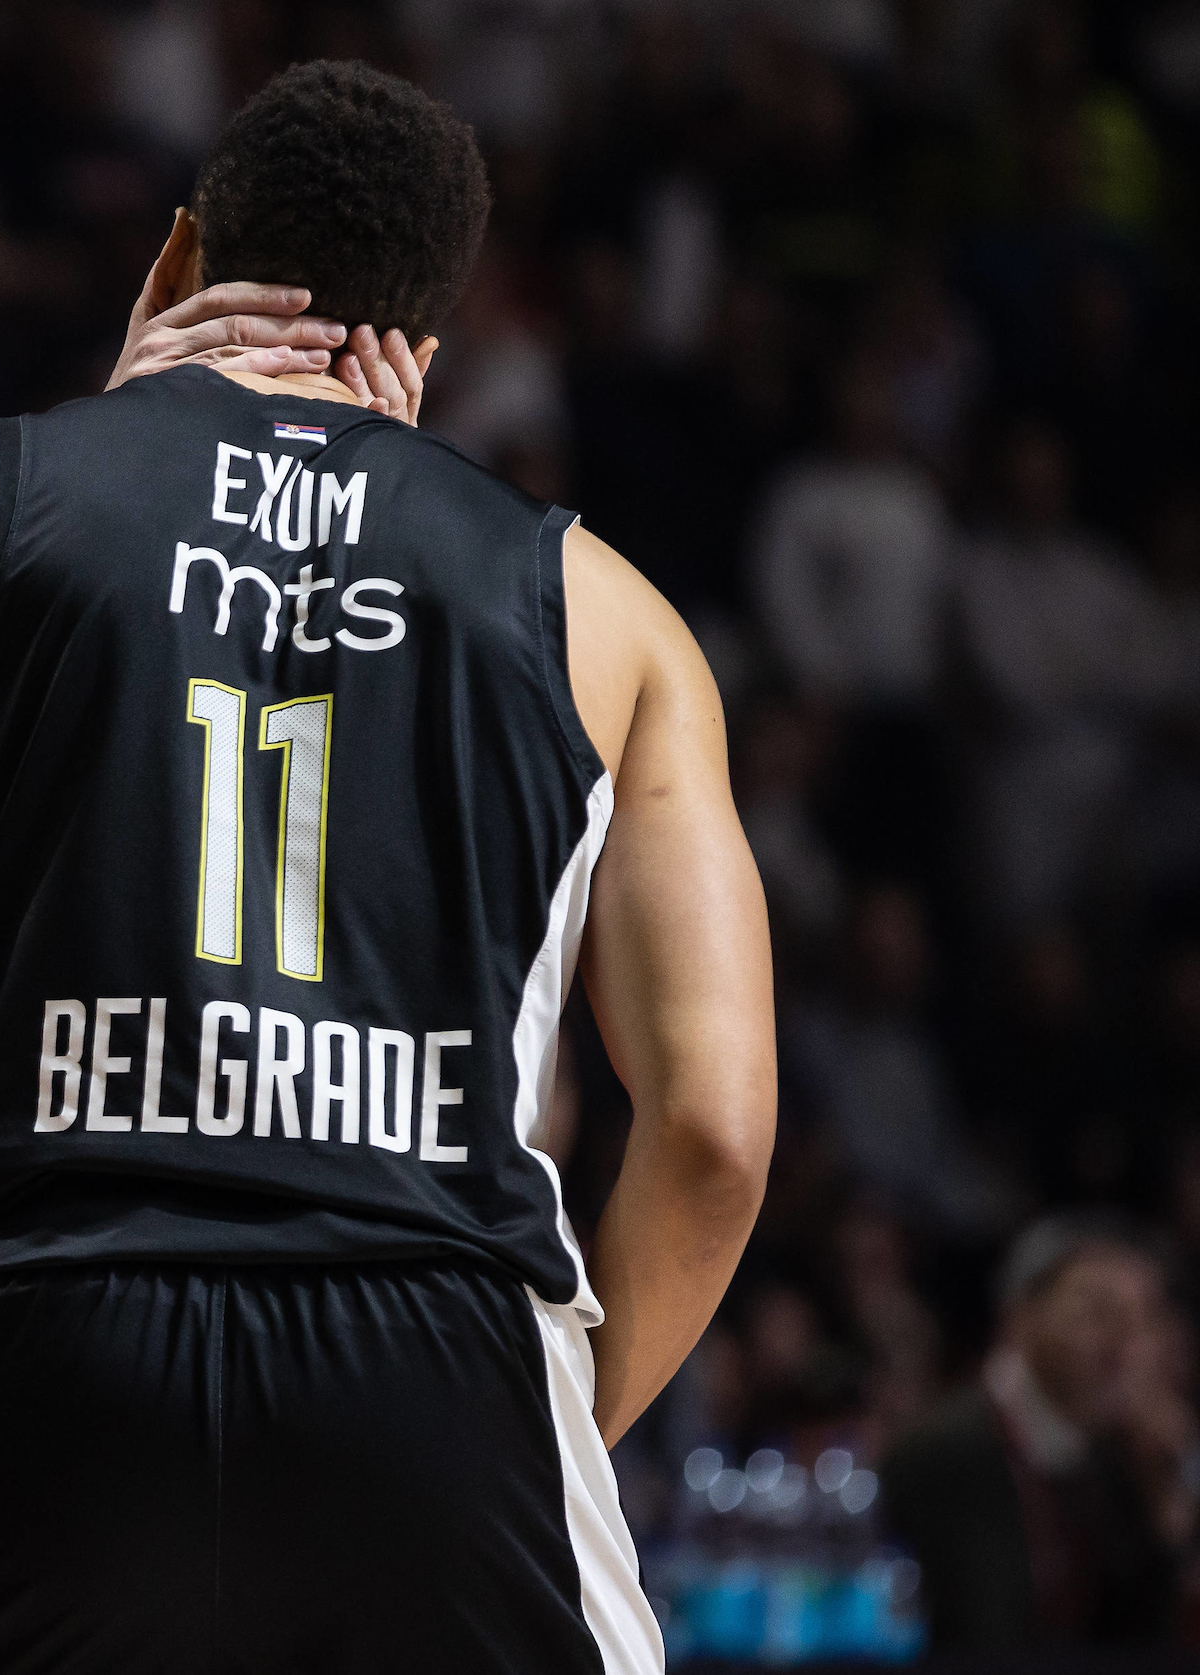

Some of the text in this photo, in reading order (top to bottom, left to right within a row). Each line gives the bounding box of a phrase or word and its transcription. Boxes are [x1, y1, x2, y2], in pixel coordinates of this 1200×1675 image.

[211, 440, 369, 552] EXUM
[168, 540, 408, 653] mts
[186, 677, 335, 983] 11
[33, 997, 473, 1163] BELGRADE
